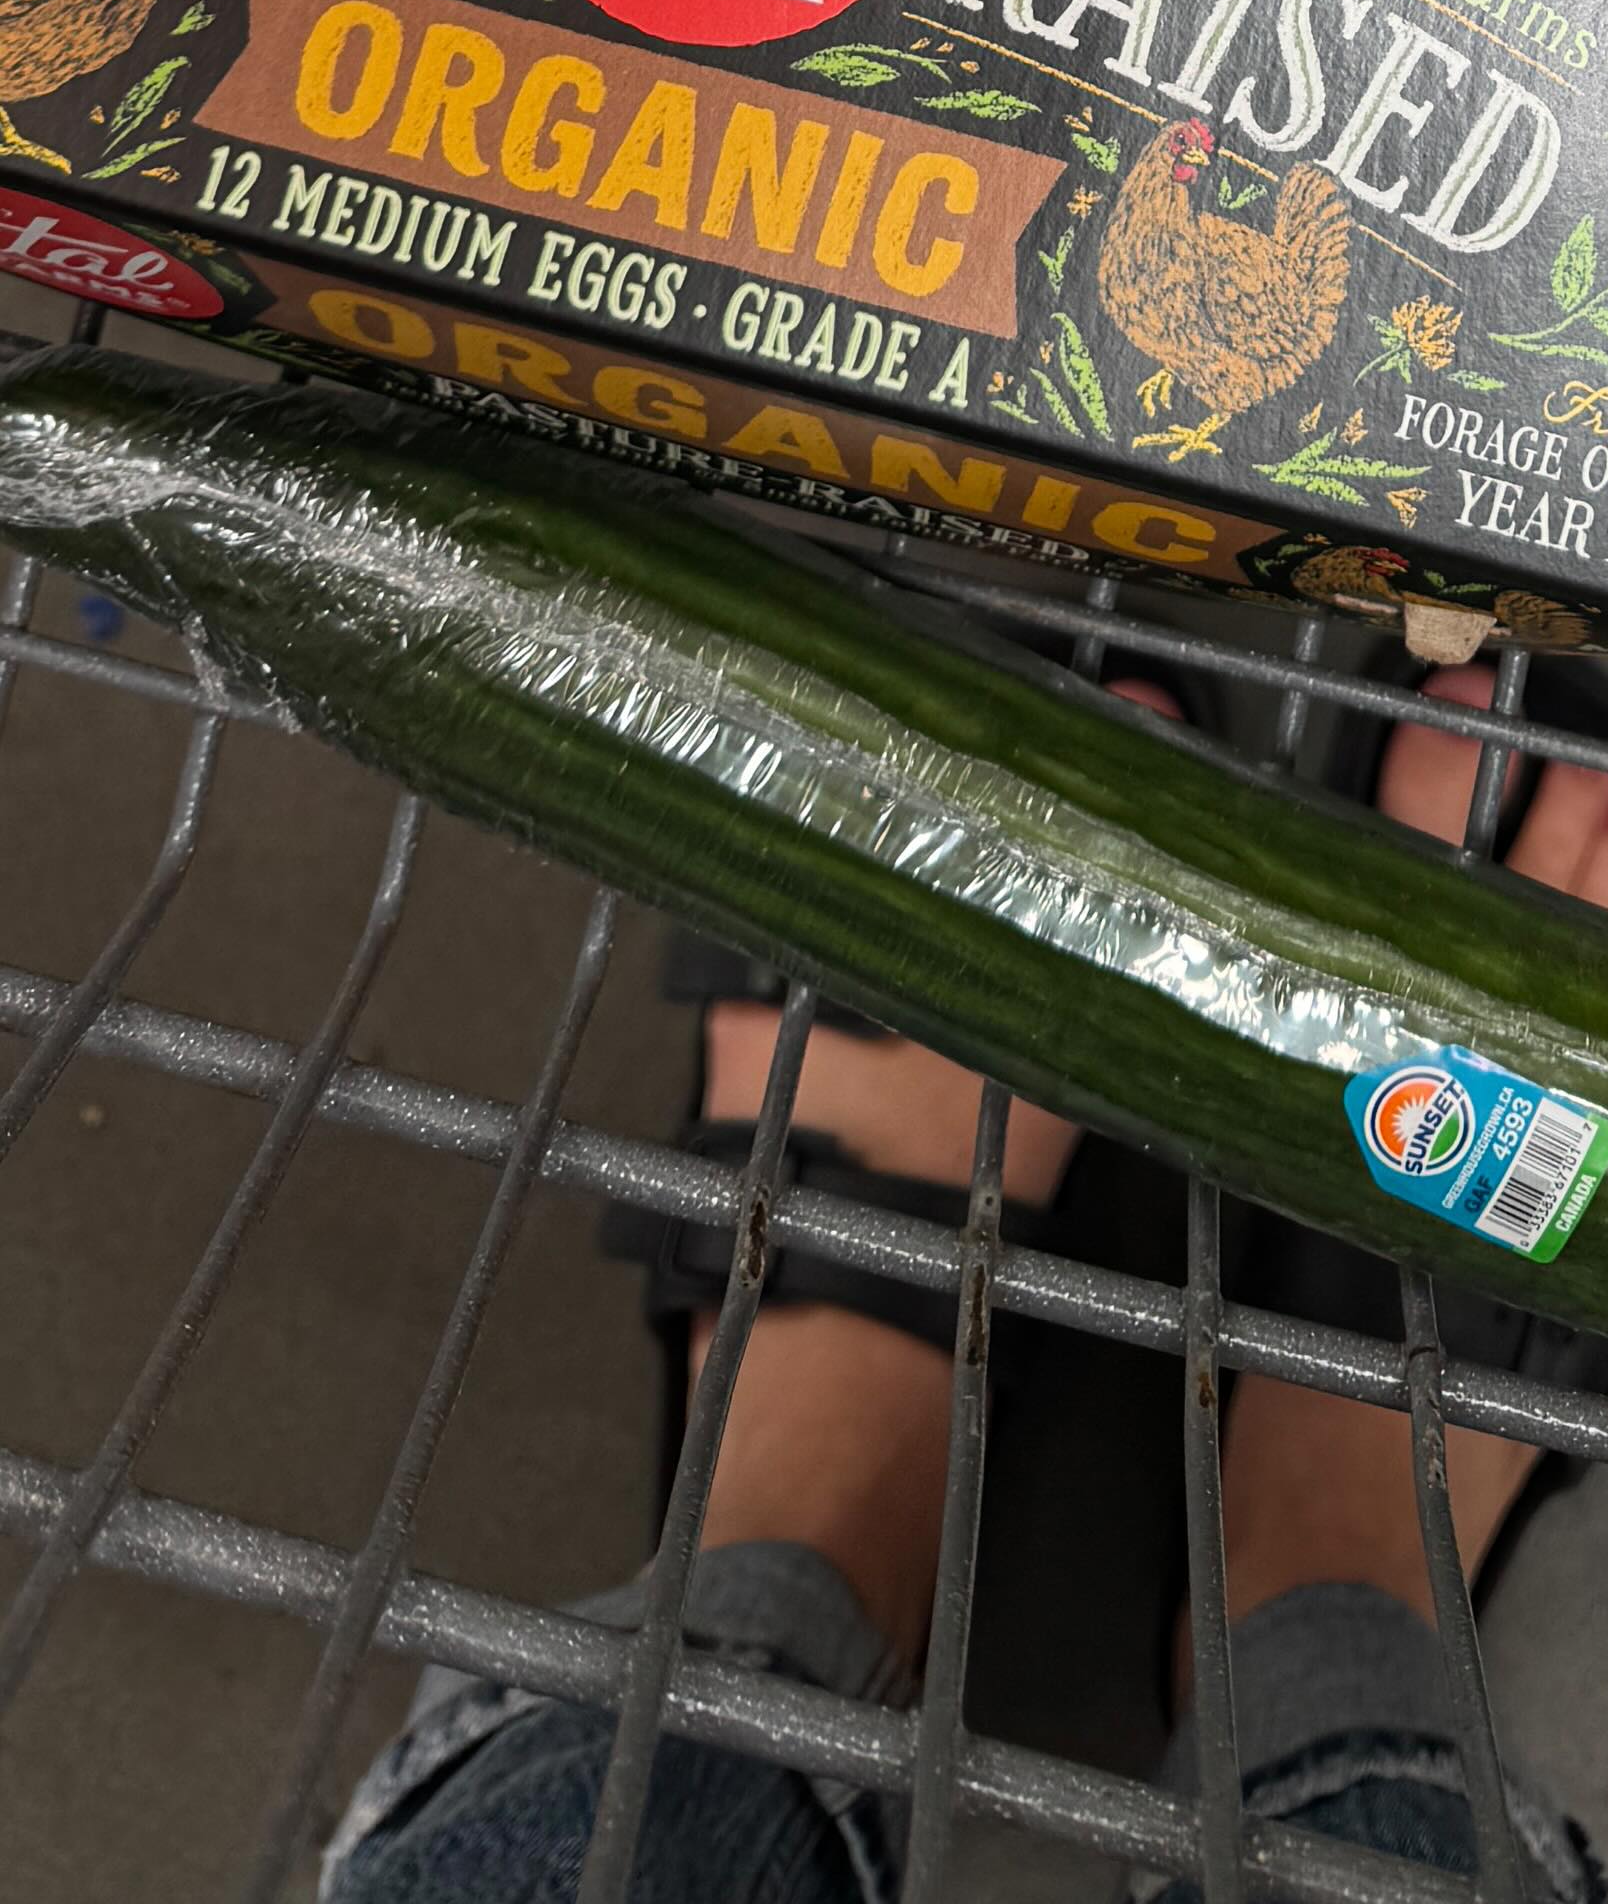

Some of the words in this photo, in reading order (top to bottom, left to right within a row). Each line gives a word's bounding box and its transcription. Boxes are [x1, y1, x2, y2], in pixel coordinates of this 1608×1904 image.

[295, 0, 978, 299] ORGANIC
[199, 145, 260, 217] 12
[275, 162, 518, 287] MEDIUM
[527, 233, 688, 331] EGGS
[721, 280, 920, 393] GRADE
[926, 336, 970, 411] A
[309, 288, 1217, 563] ORGANIC
[1396, 393, 1564, 479] FORAGE
[1454, 466, 1596, 561] YEAR
[1405, 1079, 1465, 1175] SUNSET
[1491, 1097, 1533, 1161] 4593
[1555, 1174, 1597, 1233] CANADA
